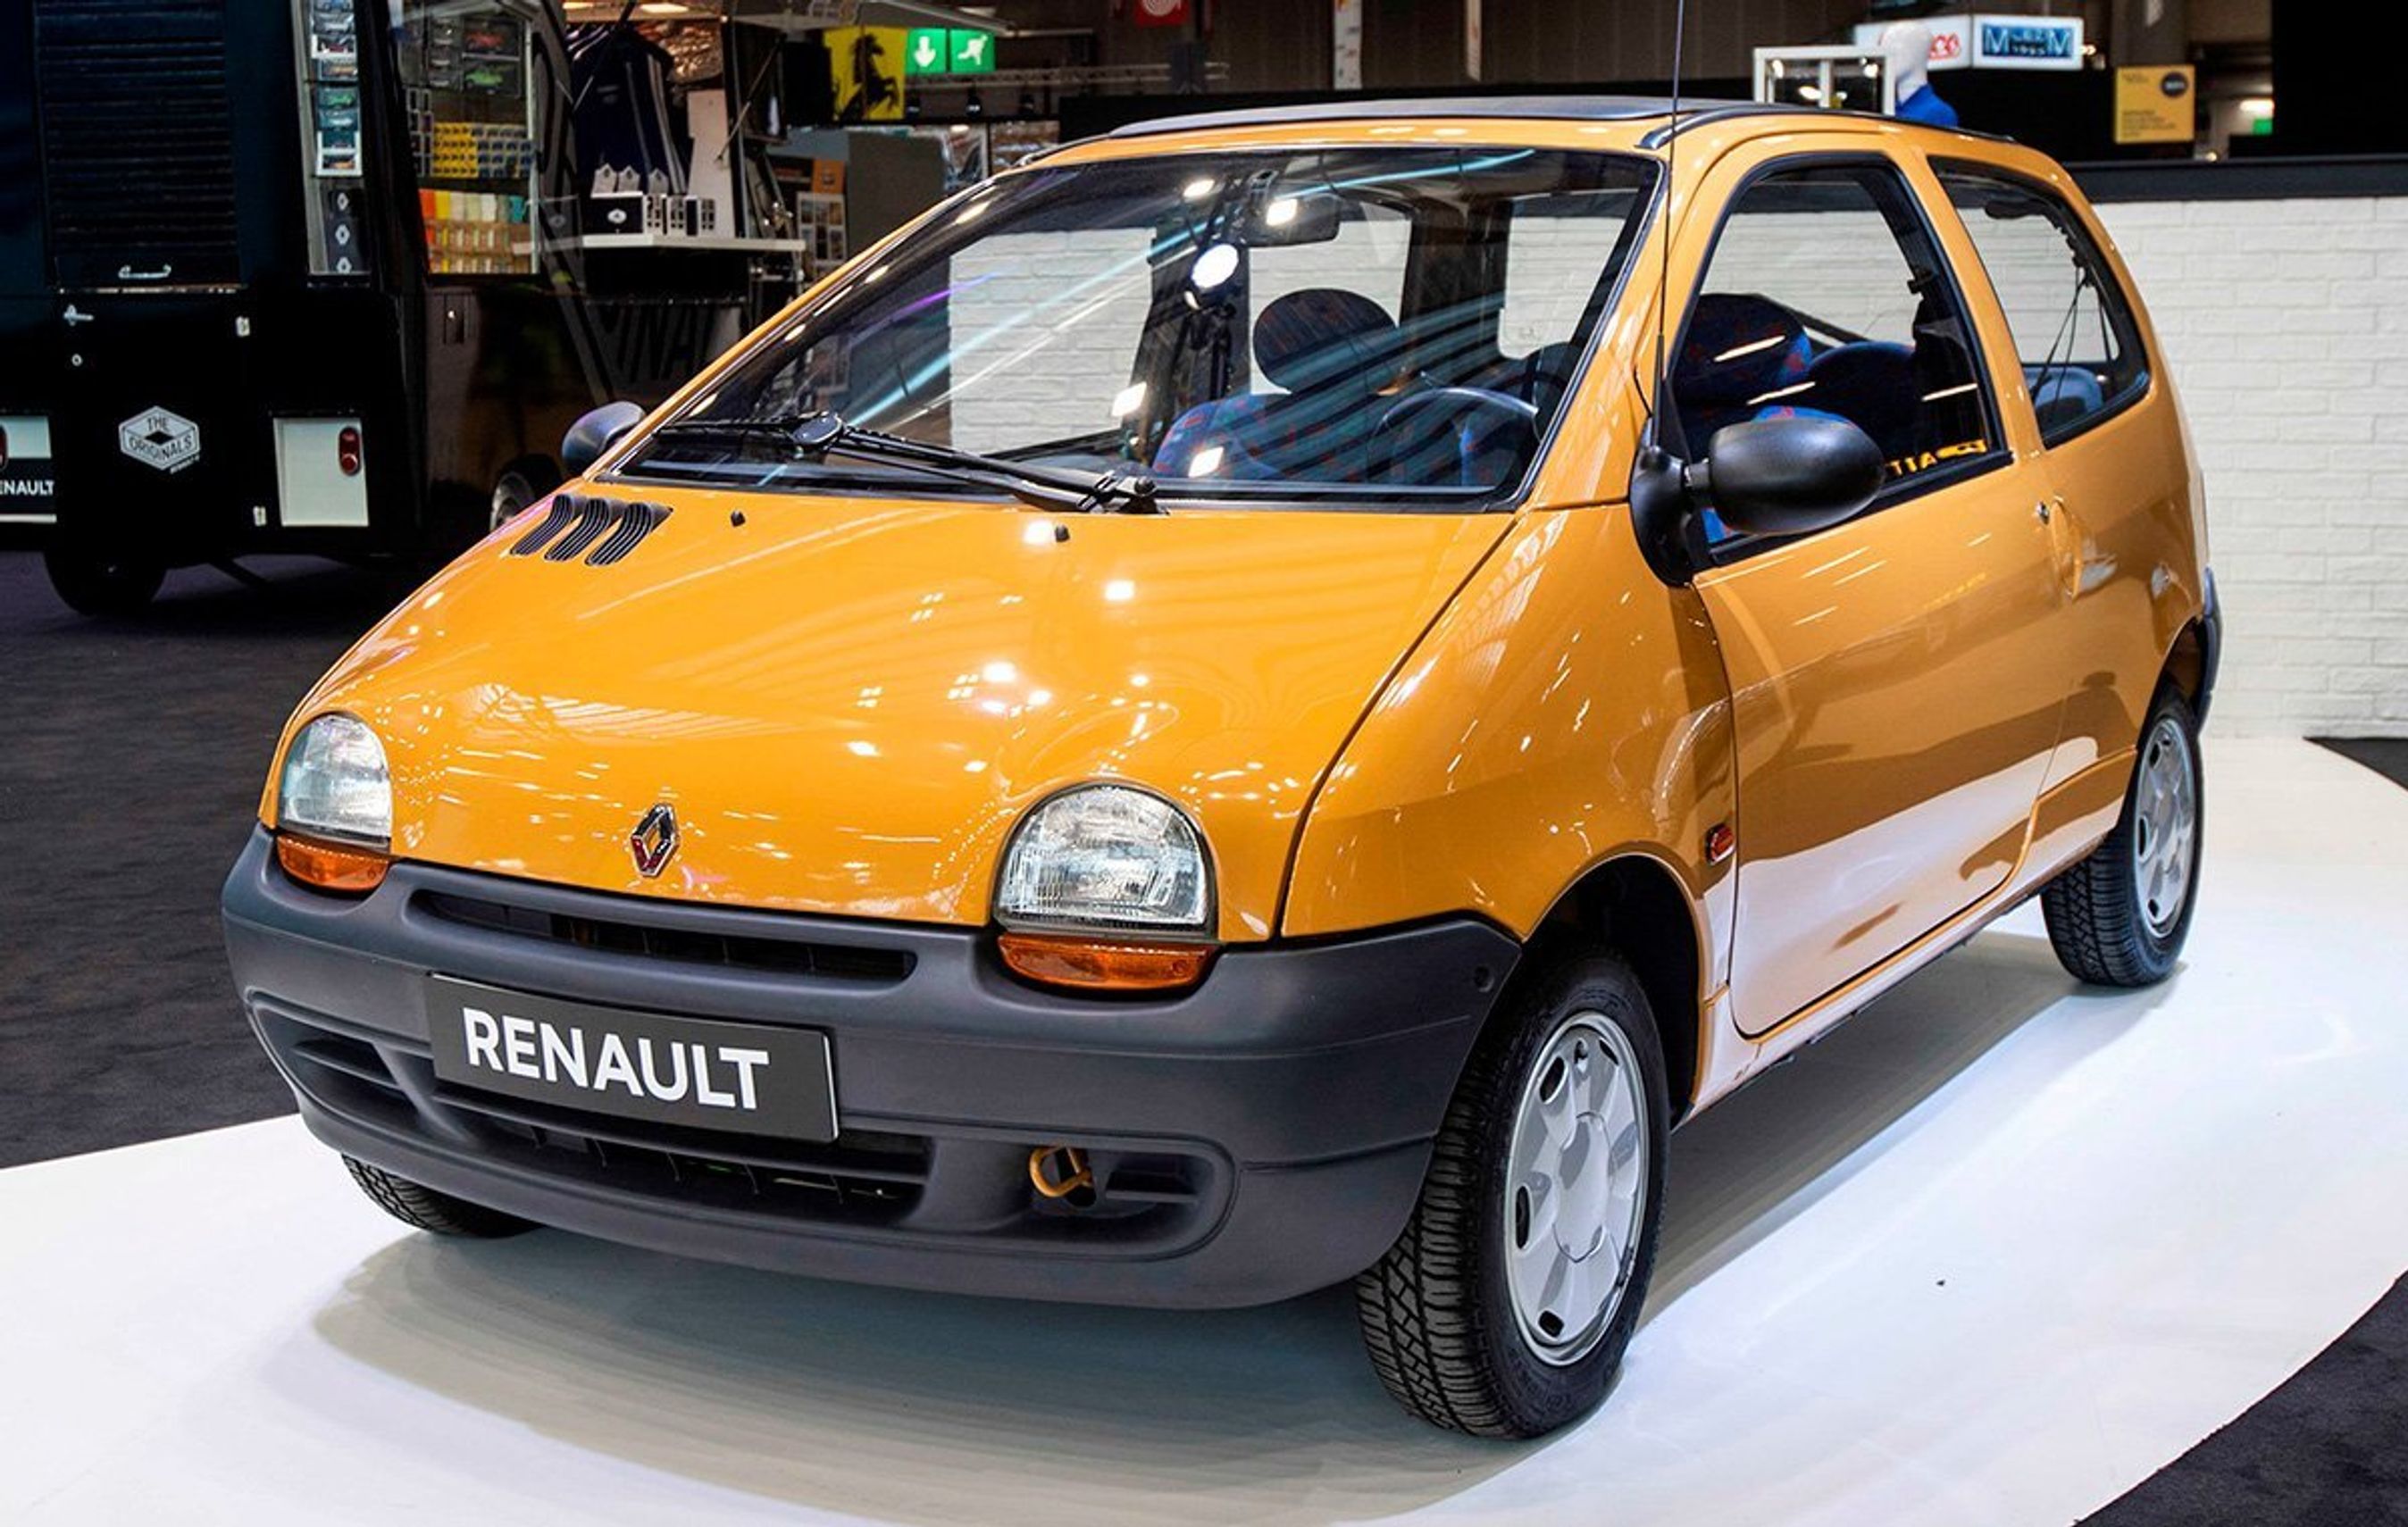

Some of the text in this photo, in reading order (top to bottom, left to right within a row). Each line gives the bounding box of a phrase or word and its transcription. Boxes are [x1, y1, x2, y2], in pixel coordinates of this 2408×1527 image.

[147, 416, 169, 432] THE
[128, 434, 192, 461] ORIGINALS
[462, 1006, 770, 1110] RENAULT
